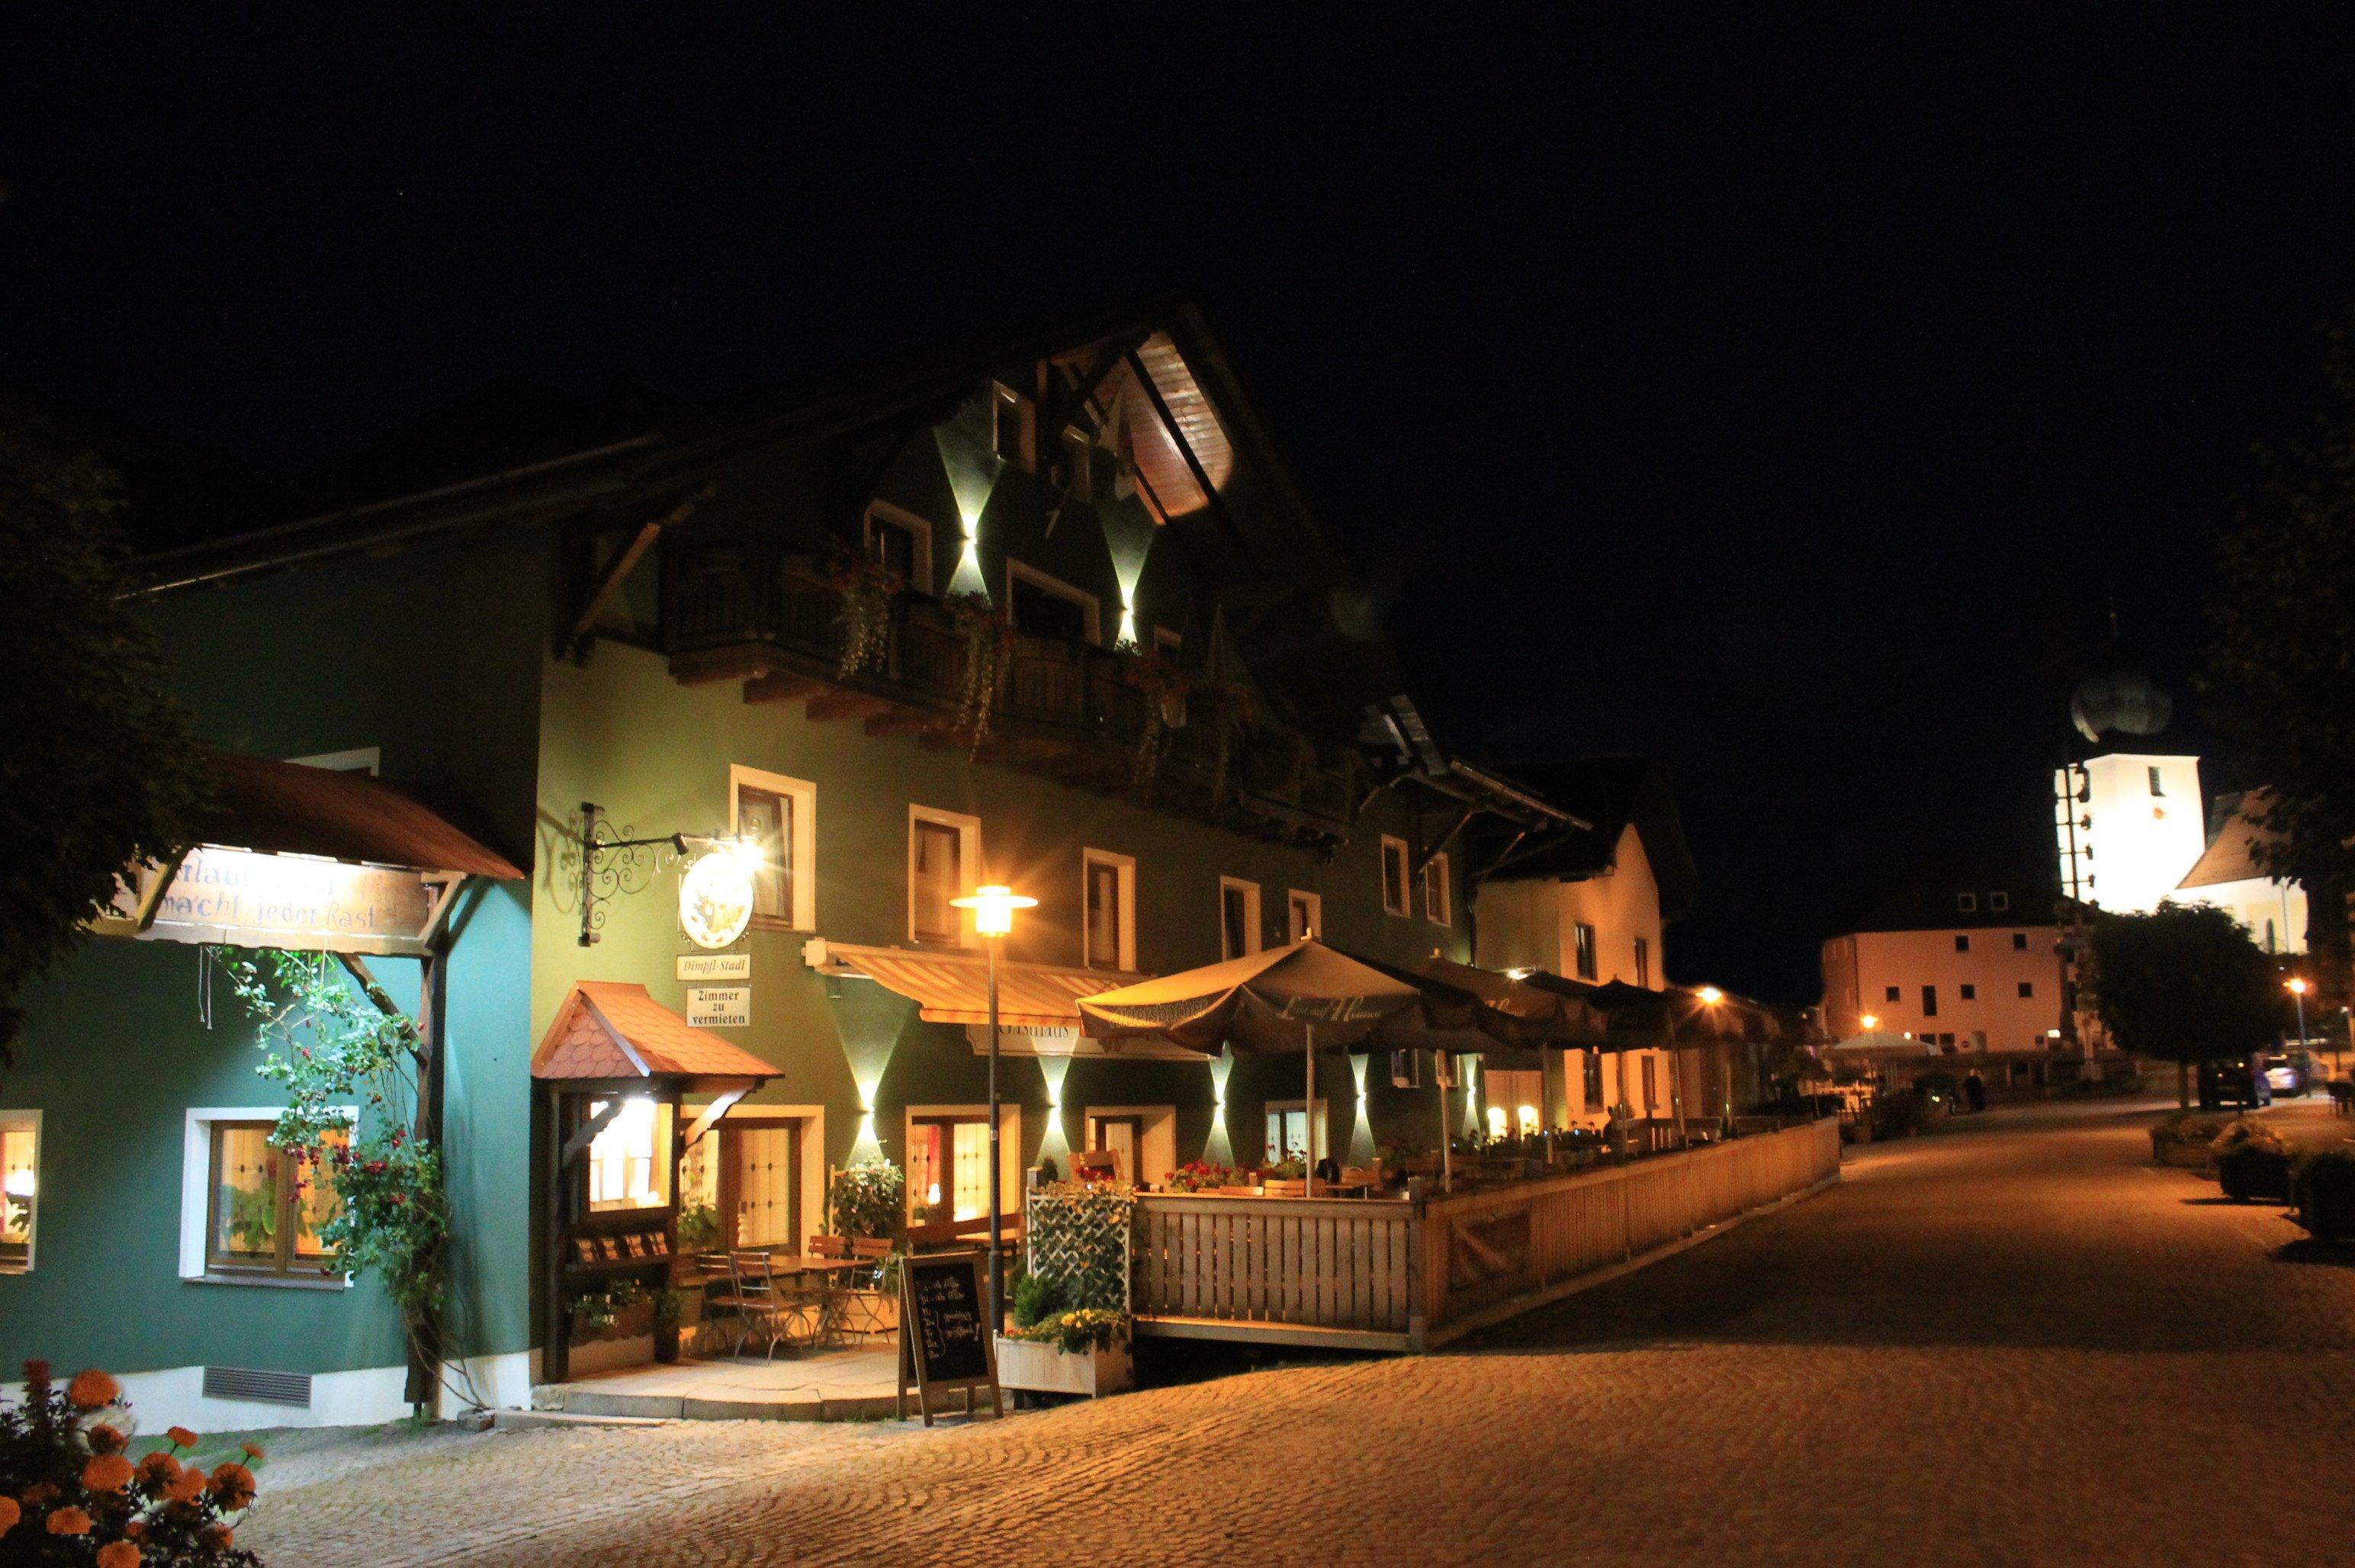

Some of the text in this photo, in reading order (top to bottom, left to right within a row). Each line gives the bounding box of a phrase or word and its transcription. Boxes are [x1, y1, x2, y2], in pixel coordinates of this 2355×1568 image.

[326, 900, 375, 927] Rast
[683, 959, 746, 975] Dimpfl-Stadl
[698, 990, 739, 1001] Zimmer
[712, 1003, 724, 1012] zu
[692, 1014, 746, 1025] vermieten
